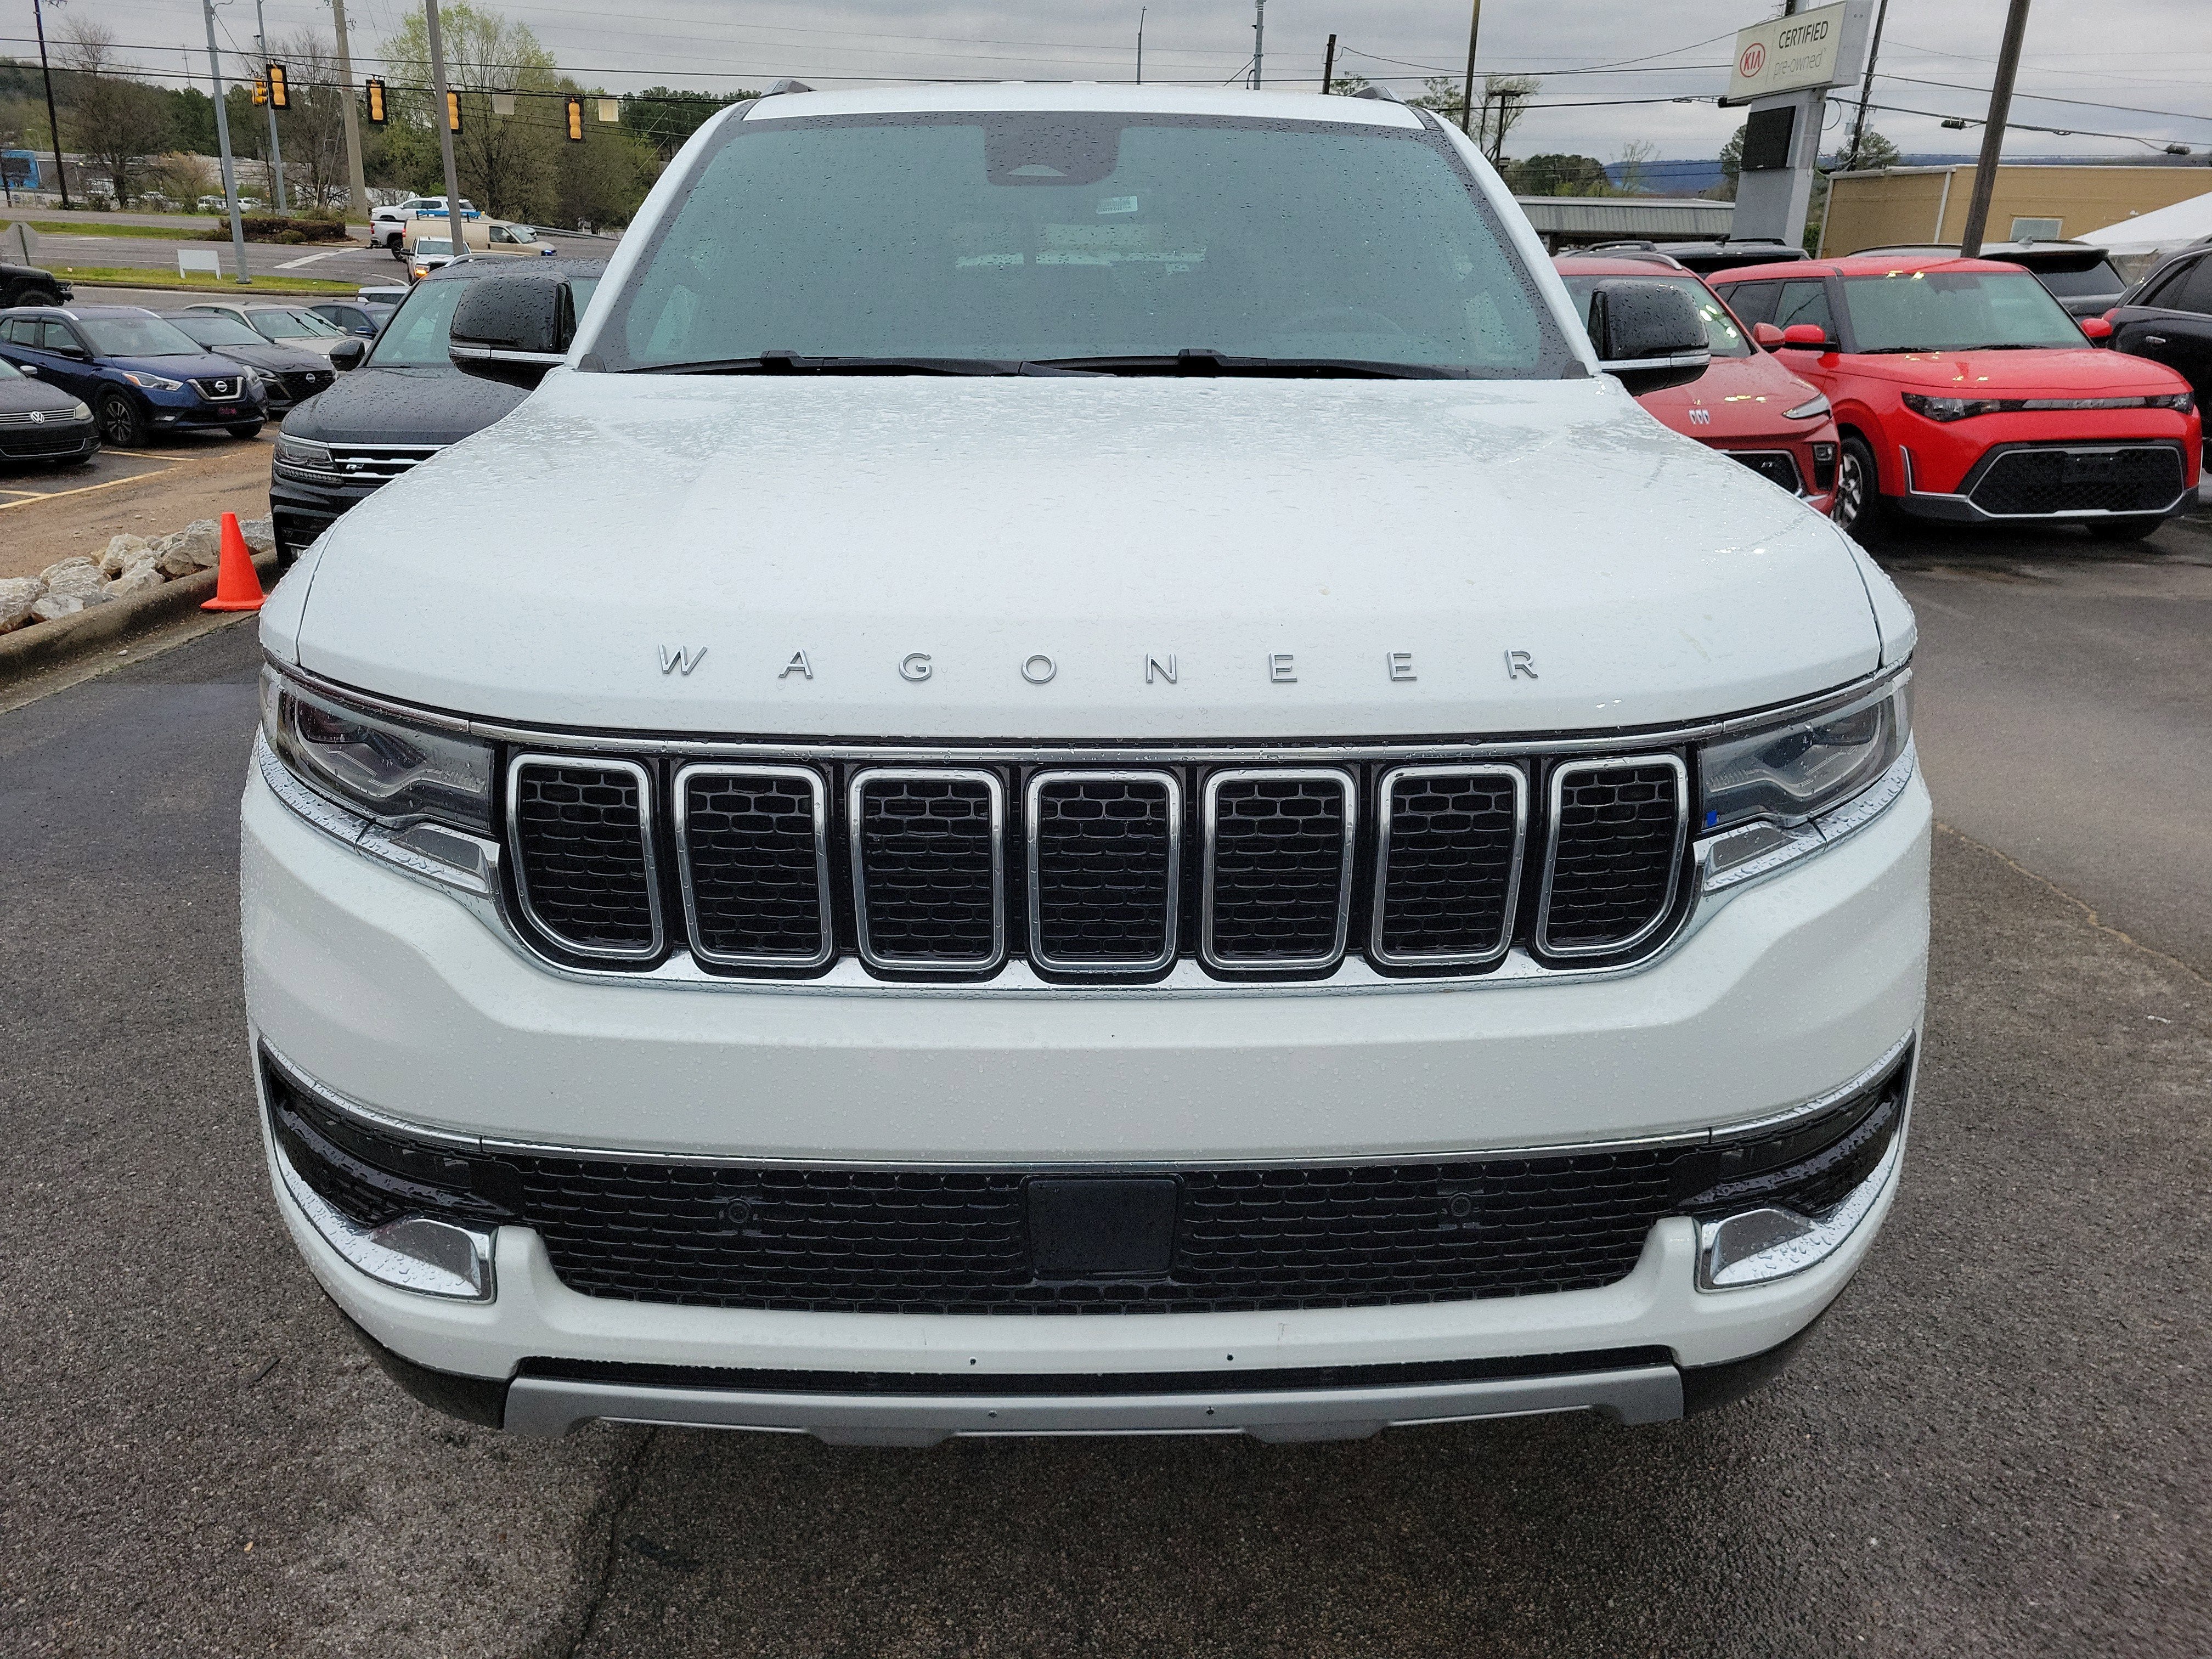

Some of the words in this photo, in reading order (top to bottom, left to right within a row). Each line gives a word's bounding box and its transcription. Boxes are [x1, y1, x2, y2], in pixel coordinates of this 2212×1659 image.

[1779, 20, 1829, 49] CERTIFIED
[1743, 50, 1761, 71] KIA
[1774, 53, 1822, 76] pre-owned
[658, 643, 1538, 684] WAGONEER
